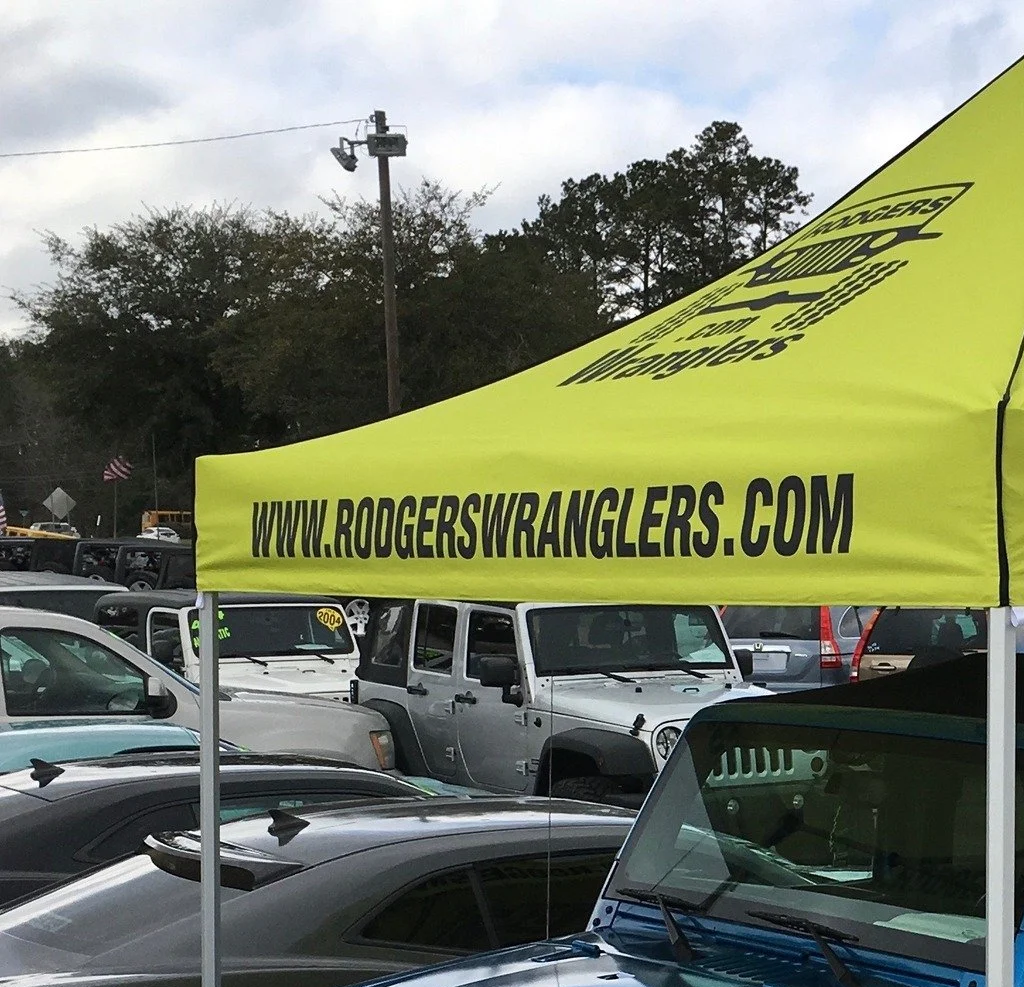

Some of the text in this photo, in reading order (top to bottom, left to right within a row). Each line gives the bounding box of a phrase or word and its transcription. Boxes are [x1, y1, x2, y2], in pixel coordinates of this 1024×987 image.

[808, 195, 952, 238] RODGERS
[674, 315, 760, 343] .com
[556, 333, 805, 387] Wranglers
[251, 473, 854, 560] WWW.RODGERSWRANGLERS.COM
[318, 611, 341, 626] 2004
